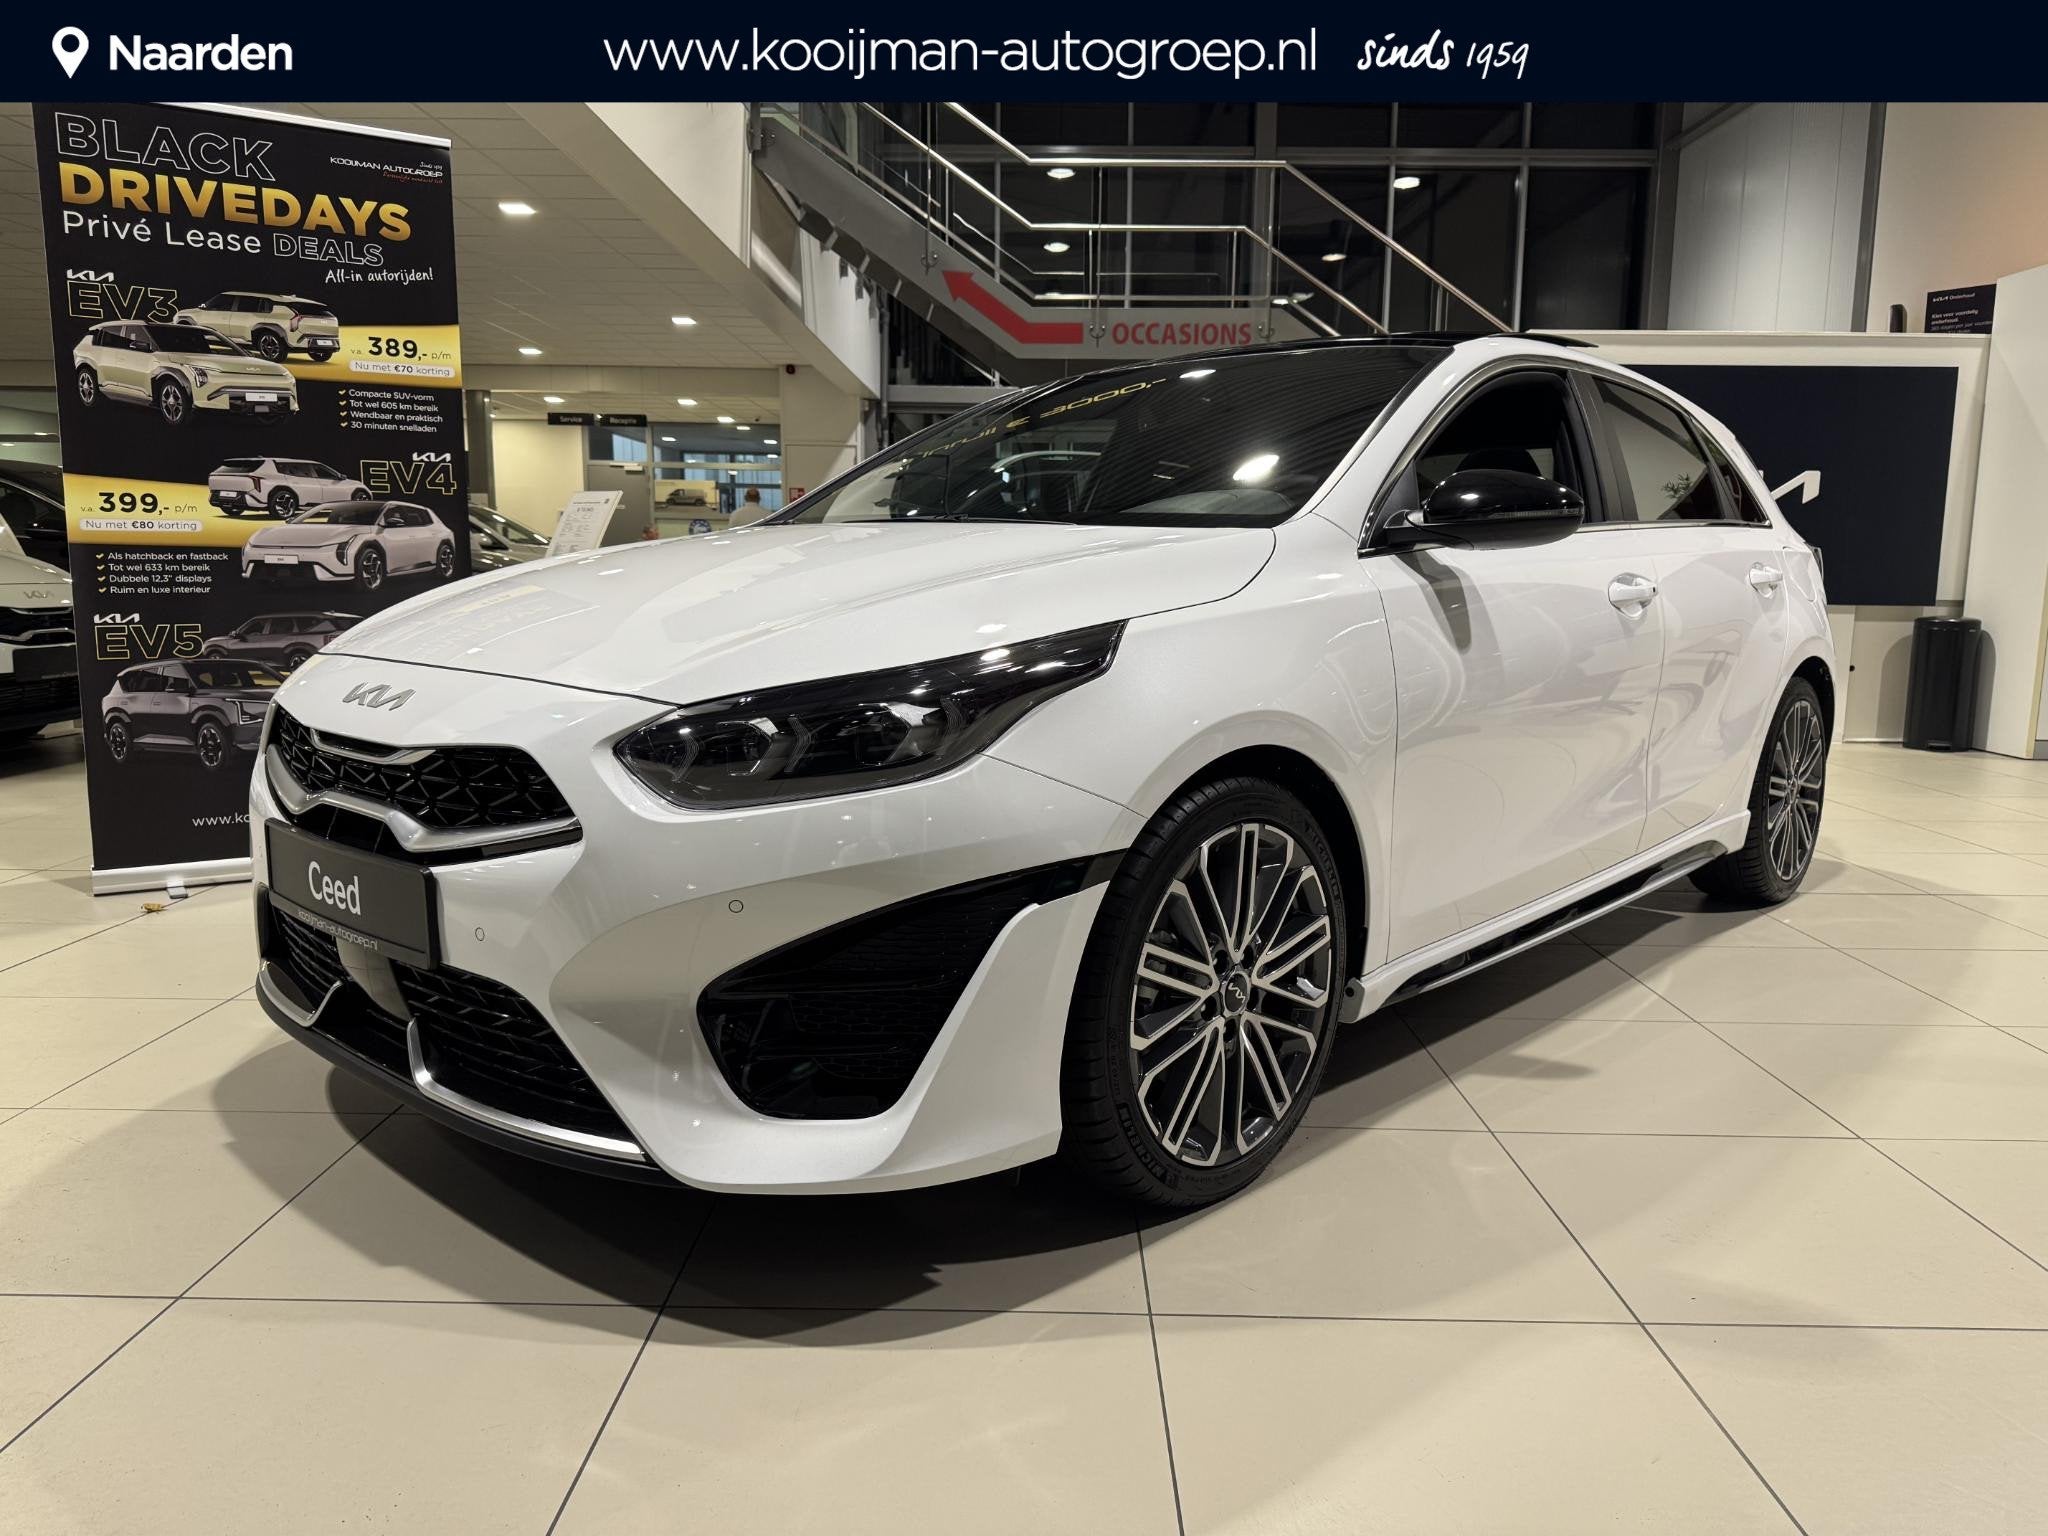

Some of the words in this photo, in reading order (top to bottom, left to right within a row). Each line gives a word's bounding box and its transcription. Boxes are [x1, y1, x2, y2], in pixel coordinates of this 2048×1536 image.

[55, 112, 276, 181] BLACK
[383, 165, 443, 178] AUTOGROEP
[59, 162, 411, 241] DRIVEDAYS
[63, 210, 152, 242] Privé
[165, 222, 261, 254] Lease
[273, 233, 384, 266] DEALS
[325, 269, 363, 284] All-in
[368, 267, 434, 285] autorijden!
[67, 280, 178, 323] EV3
[1111, 321, 1252, 346] OCCASIONS
[368, 336, 427, 361] 389,-
[431, 351, 452, 360] p/m
[355, 362, 369, 370] Nu
[372, 363, 391, 372] met
[394, 364, 413, 373] €70
[416, 366, 450, 377] korting
[348, 389, 392, 399] Compacte
[393, 392, 435, 401] SUV-vorm
[350, 400, 363, 408] Tot
[364, 401, 380, 409] wel
[381, 401, 398, 410] 605
[399, 402, 412, 411] km
[413, 403, 439, 412] bereik
[350, 411, 393, 420] Wendbaar
[406, 413, 443, 424] praktisch
[350, 421, 362, 429] 30
[364, 421, 398, 431] minuten
[399, 424, 437, 433] snelladen
[360, 459, 457, 495] EV4
[98, 492, 170, 516] 399,-
[174, 504, 198, 513] p/m
[86, 520, 102, 529] Nu
[105, 521, 128, 529] met
[131, 521, 154, 529] €80
[158, 520, 197, 530] korting
[107, 552, 123, 560] Als
[125, 552, 173, 560] hatchback
[190, 552, 229, 560] fastback
[108, 563, 124, 571] Tot
[126, 563, 143, 571] wel
[144, 563, 162, 571] 633
[164, 563, 180, 571] km
[182, 563, 210, 571] bereik
[109, 574, 149, 583] Dubbele
[175, 574, 212, 585] displays
[110, 585, 135, 594] Ruim
[151, 585, 171, 594] luxe
[173, 585, 211, 594] interieur
[94, 623, 204, 660] EV5
[342, 681, 417, 711] KIA
[308, 860, 361, 915] Ceed
[298, 910, 378, 951] kooijman-autogroep.nl
